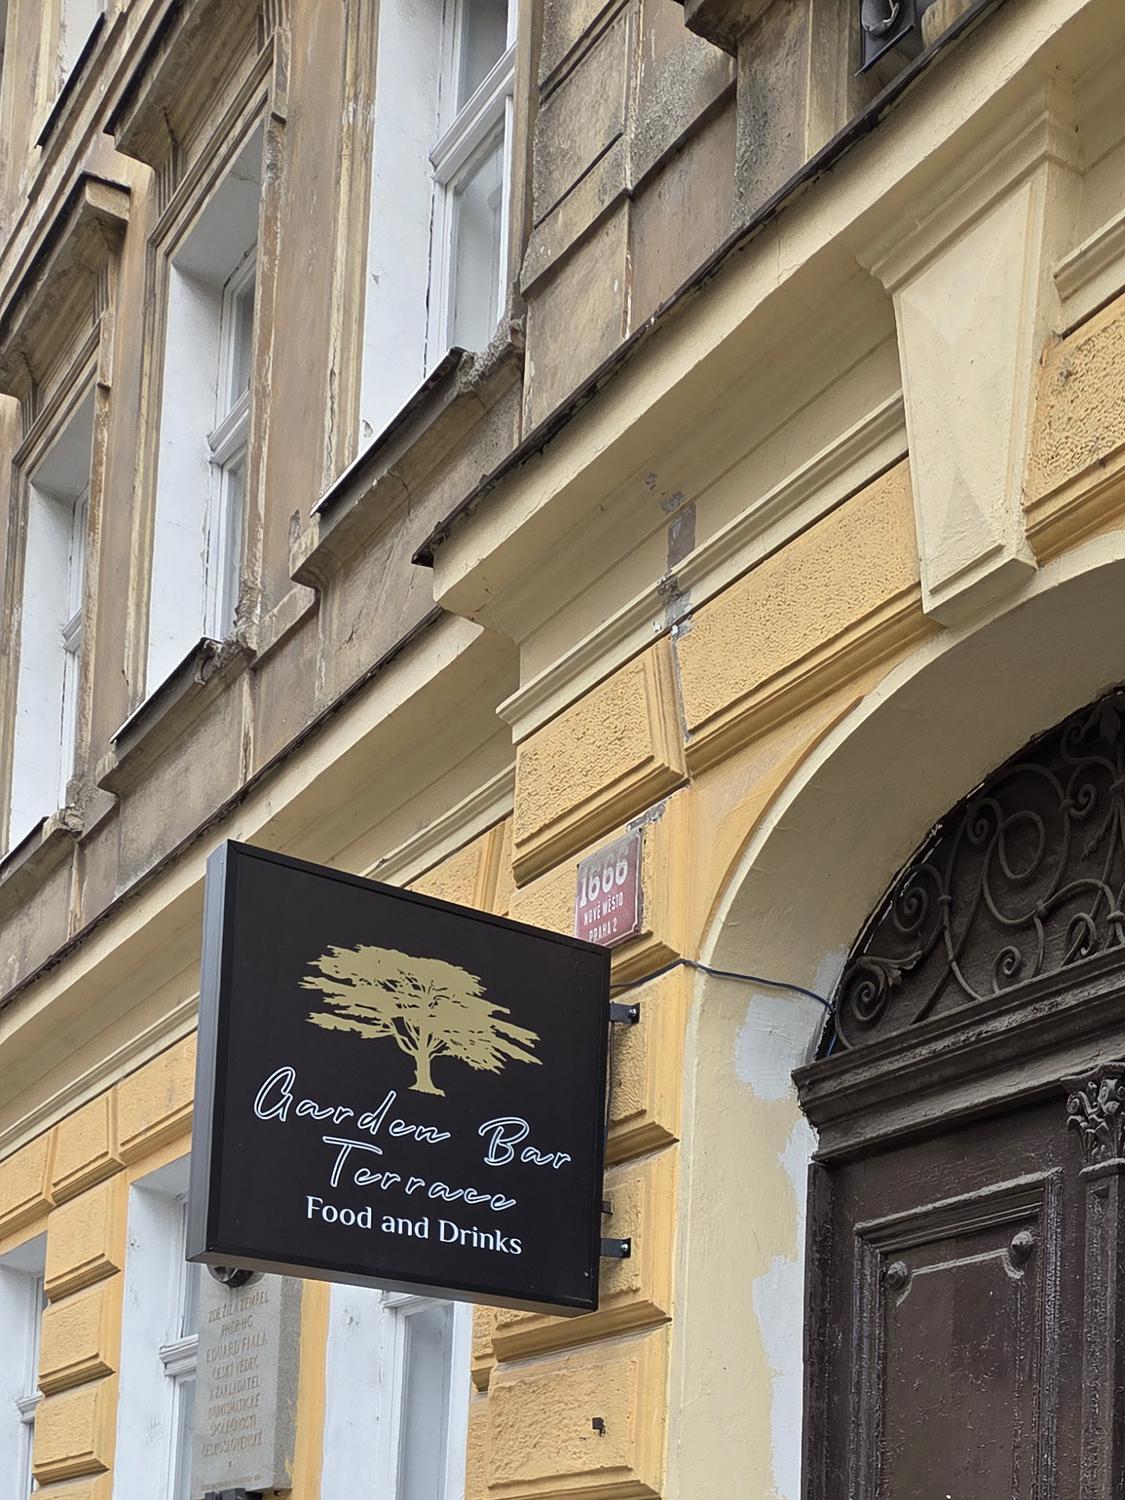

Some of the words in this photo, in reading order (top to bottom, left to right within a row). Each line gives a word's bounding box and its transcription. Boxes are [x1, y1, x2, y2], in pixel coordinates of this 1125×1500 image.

[583, 901, 601, 926] NOVÉ
[602, 892, 624, 916] MĚSTO
[589, 921, 611, 942] PRAHA
[612, 917, 618, 933] 2
[254, 1066, 451, 1144] Garden
[478, 1116, 572, 1169] Bar
[322, 1135, 518, 1212] Terrace
[306, 1196, 372, 1229] Food
[381, 1215, 429, 1239] and
[439, 1219, 523, 1255] Drinks
